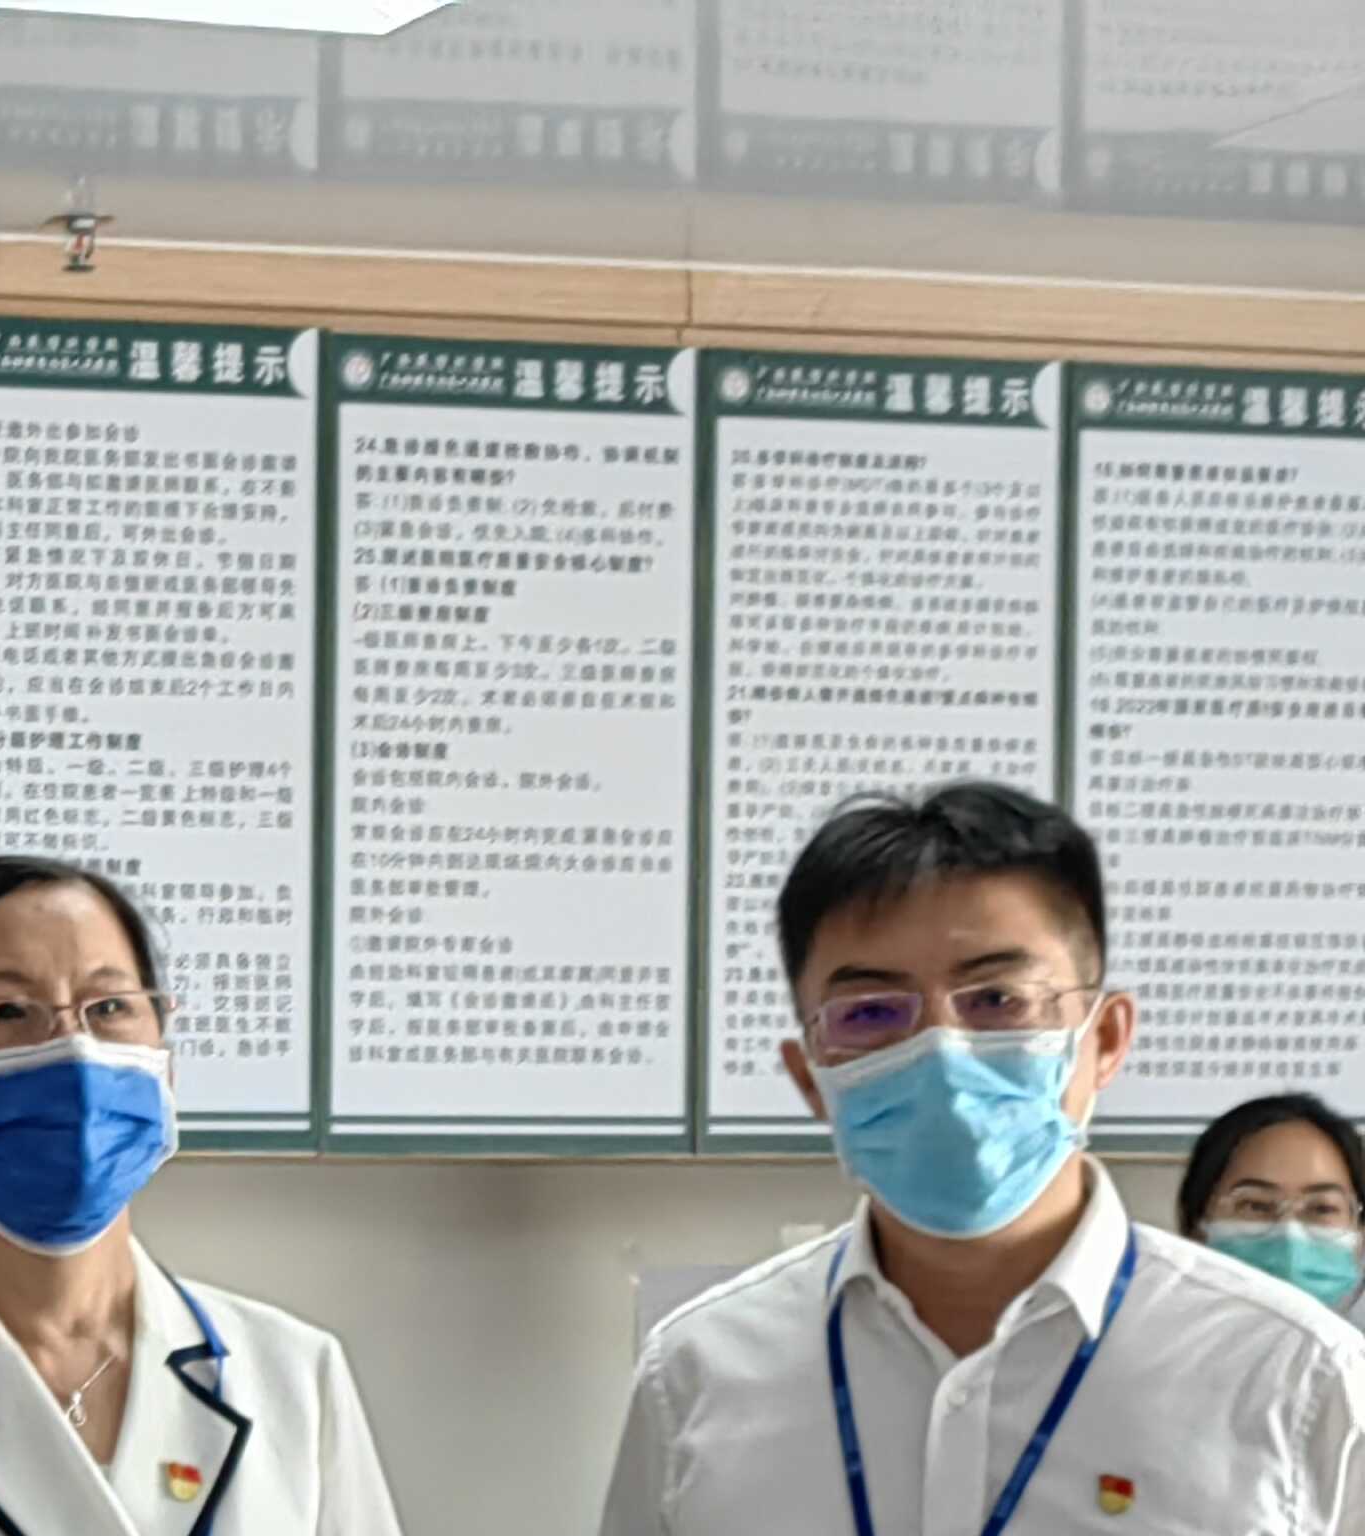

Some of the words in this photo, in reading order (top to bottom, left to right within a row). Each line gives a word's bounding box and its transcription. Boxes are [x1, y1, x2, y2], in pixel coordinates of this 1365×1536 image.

[127, 340, 286, 385] 温馨提示
[513, 359, 667, 403] 温馨提示
